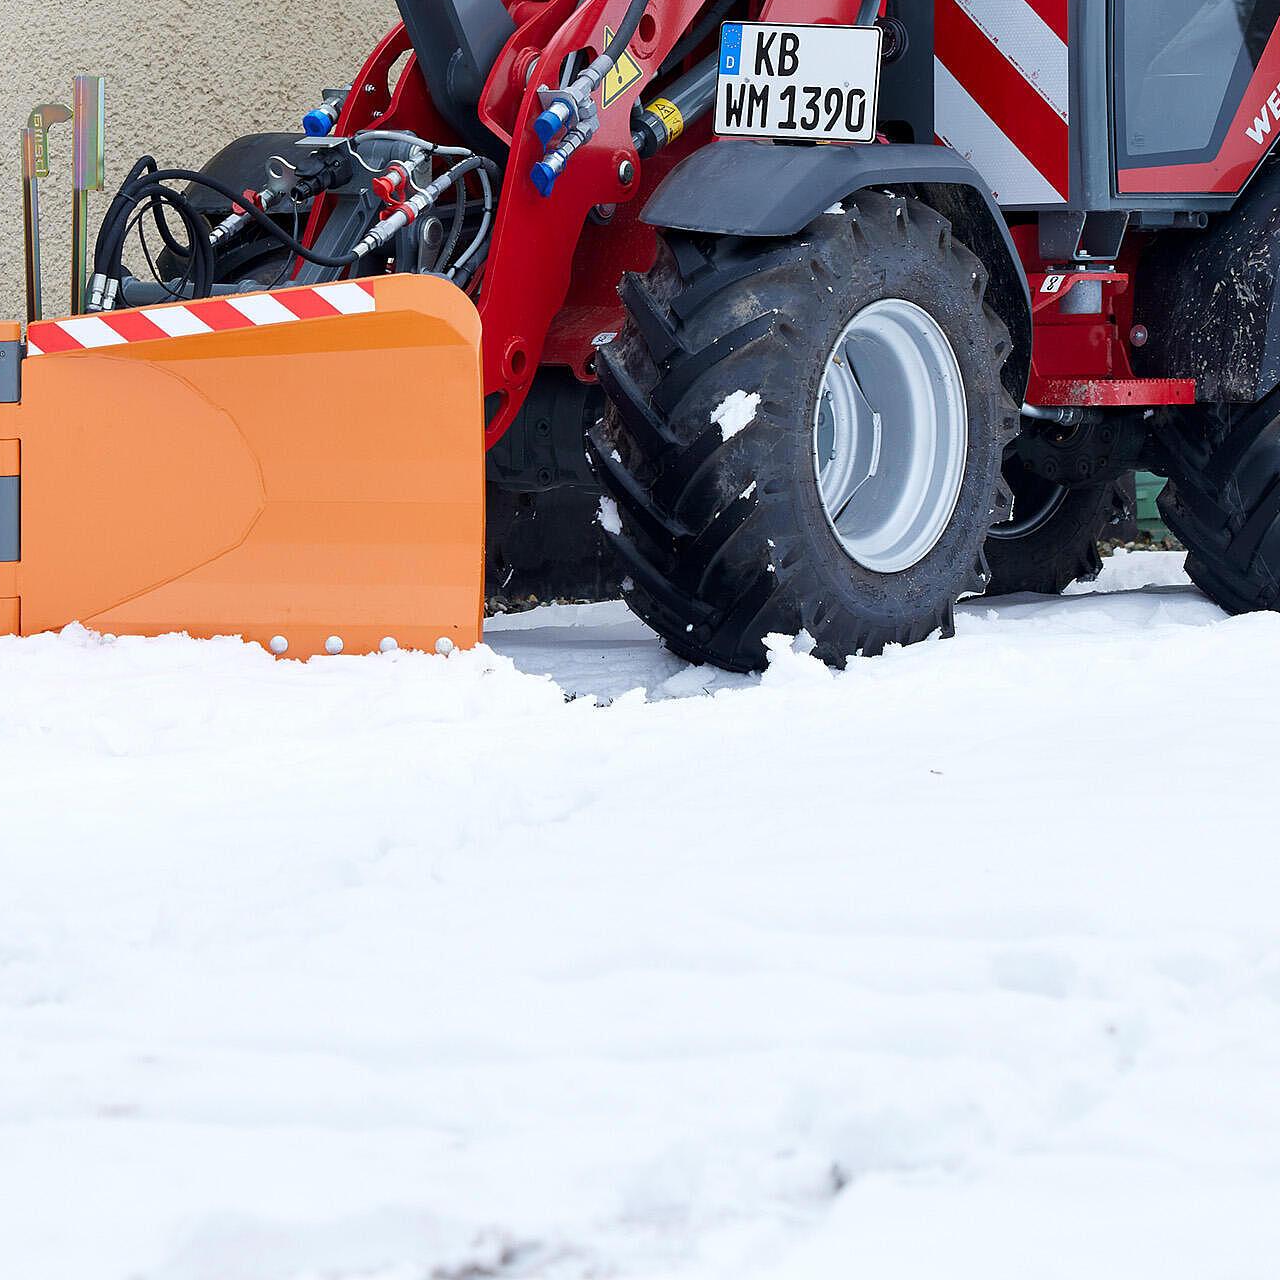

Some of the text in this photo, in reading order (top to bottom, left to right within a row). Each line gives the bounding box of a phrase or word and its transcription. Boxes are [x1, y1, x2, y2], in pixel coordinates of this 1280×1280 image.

[726, 56, 735, 69] D
[754, 31, 800, 77] KB
[726, 83, 866, 132] WM 1390
